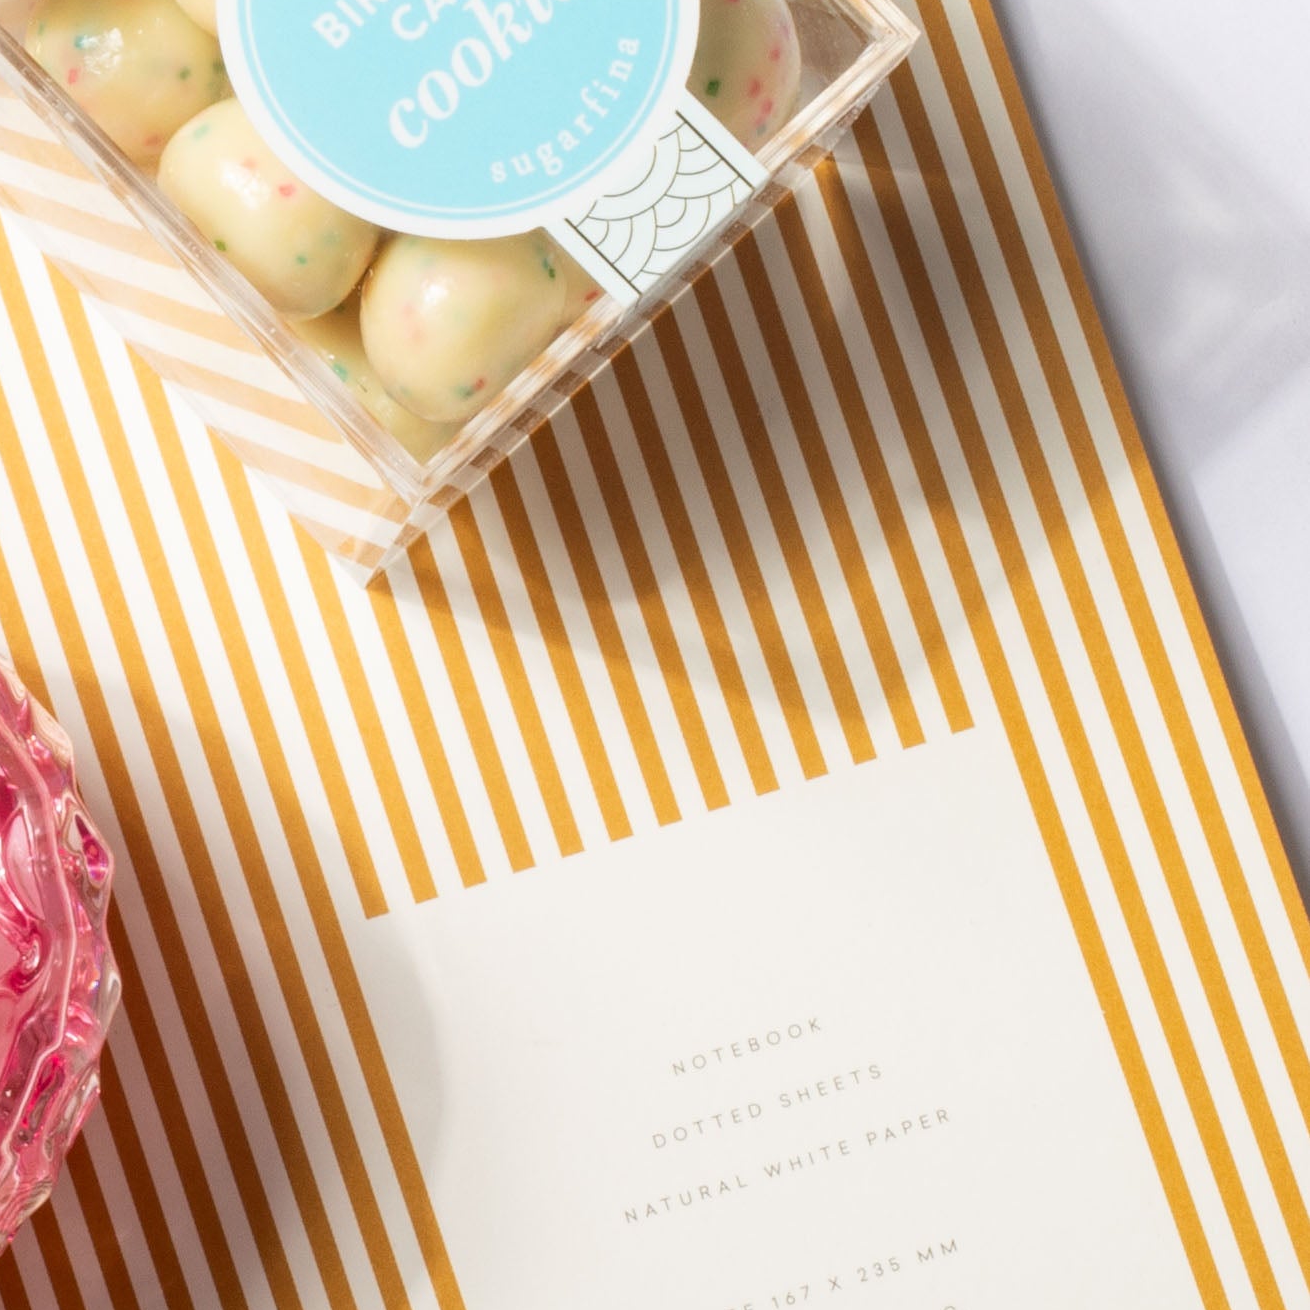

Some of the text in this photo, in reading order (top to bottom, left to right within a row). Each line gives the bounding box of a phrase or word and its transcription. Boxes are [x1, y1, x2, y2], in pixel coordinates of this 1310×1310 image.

[489, 36, 641, 184] sugarfina
[671, 1017, 823, 1077] NOTEBOOK
[652, 1063, 884, 1150] DOTTED SHEETS
[623, 1108, 951, 1225] NATURAL WHITE PAPER
[770, 1284, 812, 1310] 167
[827, 1276, 843, 1293] X
[856, 1256, 902, 1284] 235
[915, 1238, 960, 1265] MM
